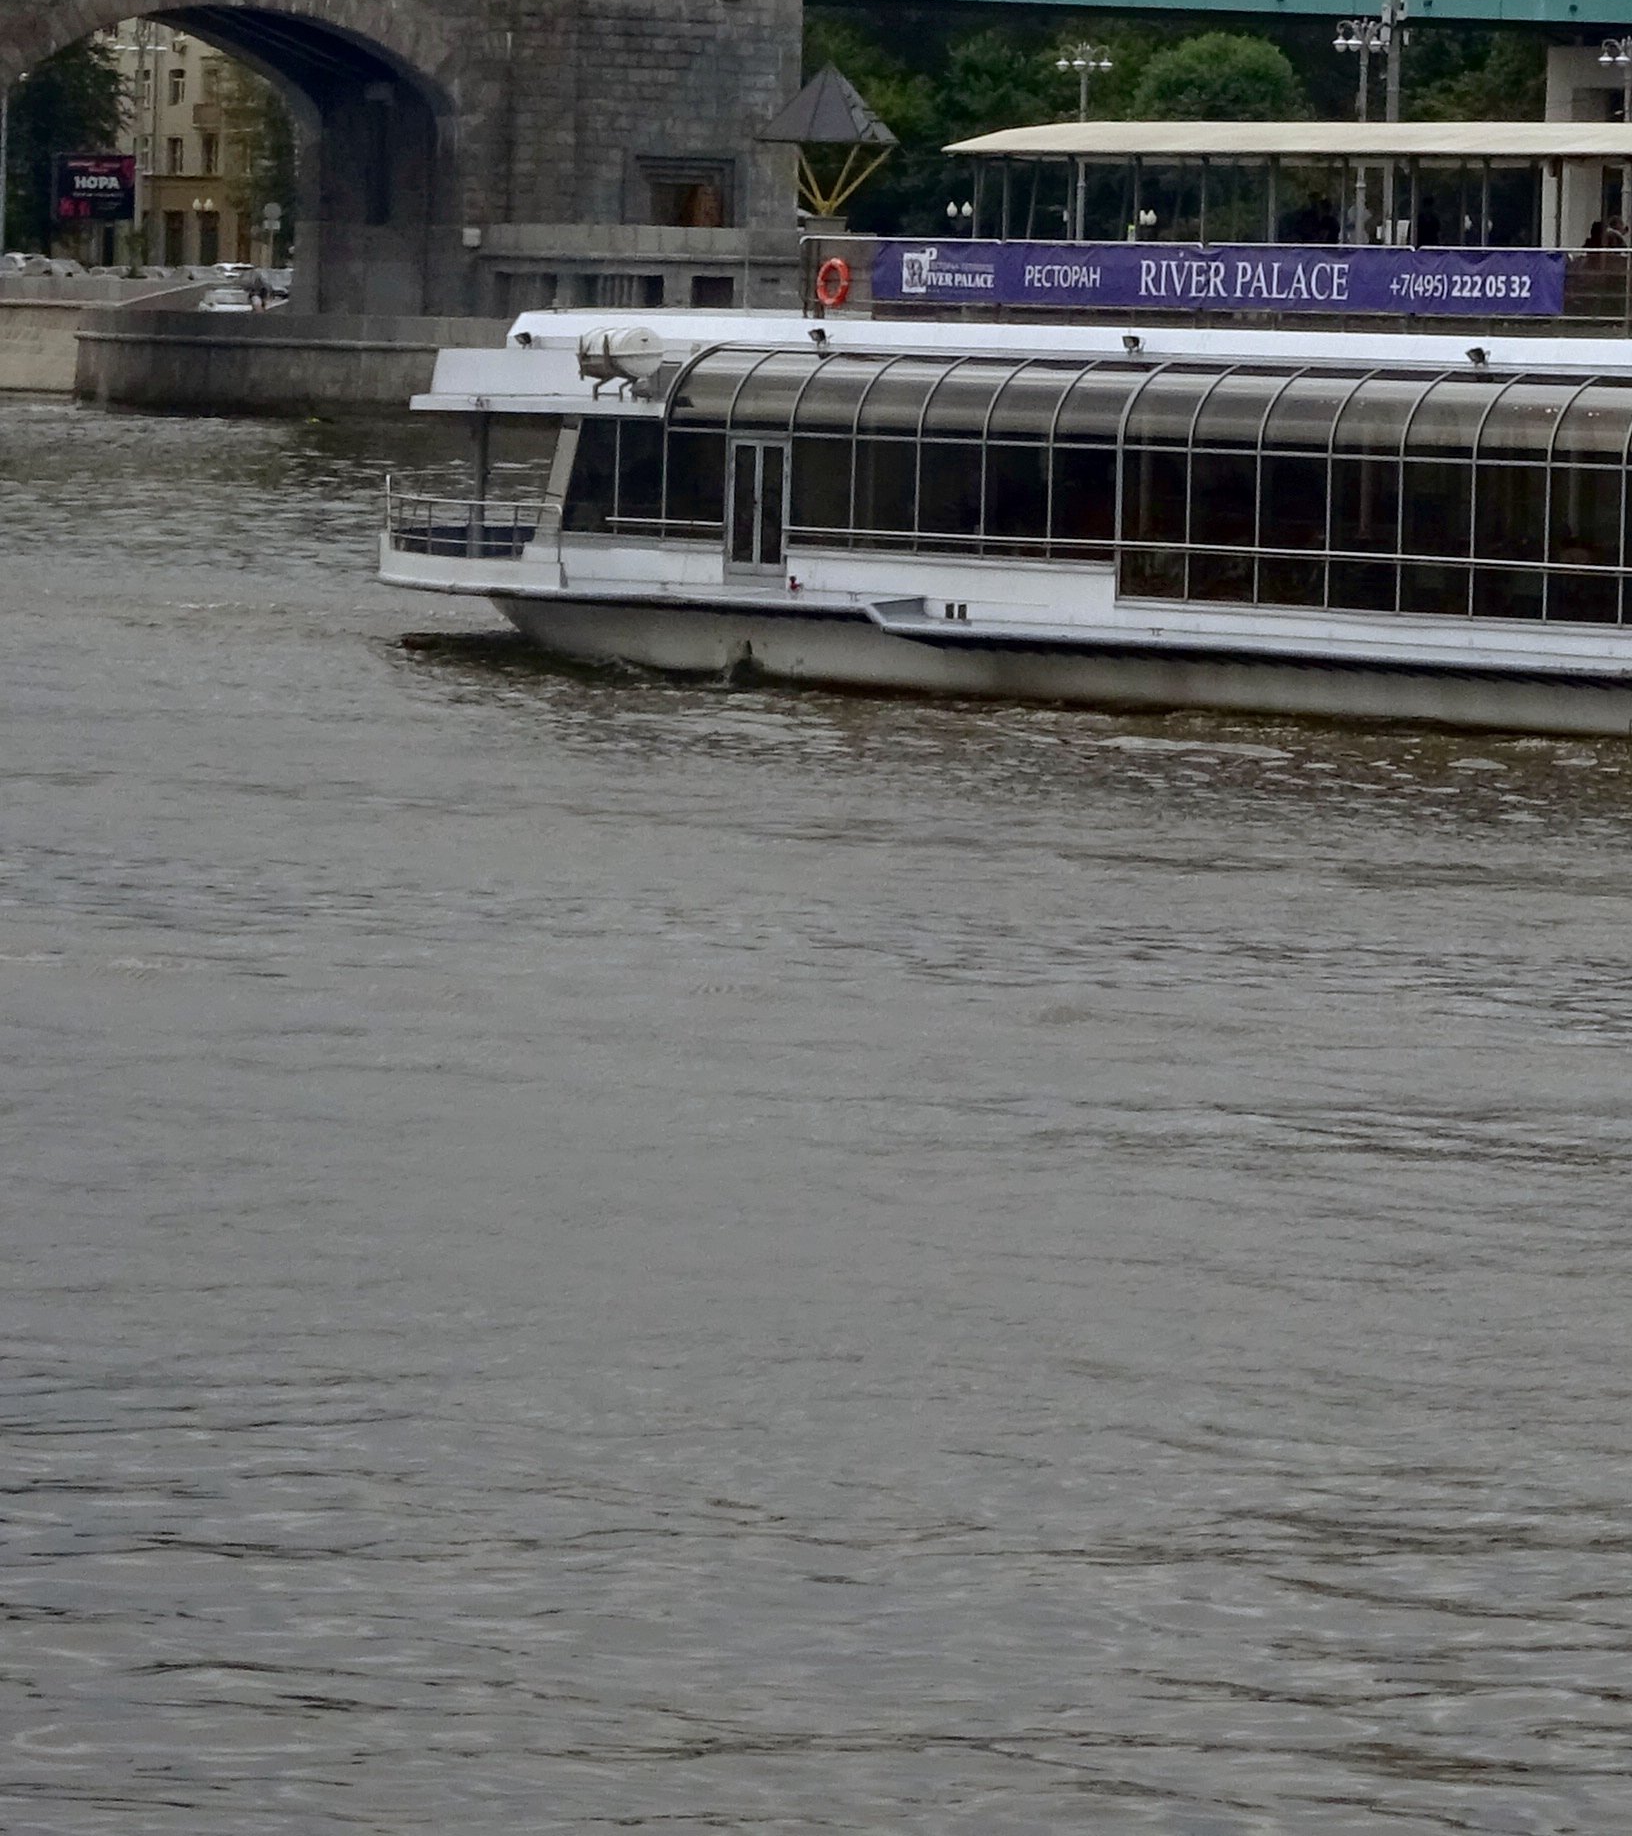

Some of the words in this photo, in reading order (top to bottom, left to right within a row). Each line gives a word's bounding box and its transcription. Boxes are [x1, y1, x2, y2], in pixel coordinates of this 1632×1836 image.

[955, 273, 995, 288] PALACE
[1024, 265, 1101, 288] РЕСТОРАН
[1138, 259, 1228, 298] RIVER
[1233, 261, 1350, 301] PALACE
[1389, 273, 1448, 301] +7(495)
[1451, 274, 1482, 298] 222
[1485, 274, 1507, 299] 05
[1510, 275, 1531, 299] 32
